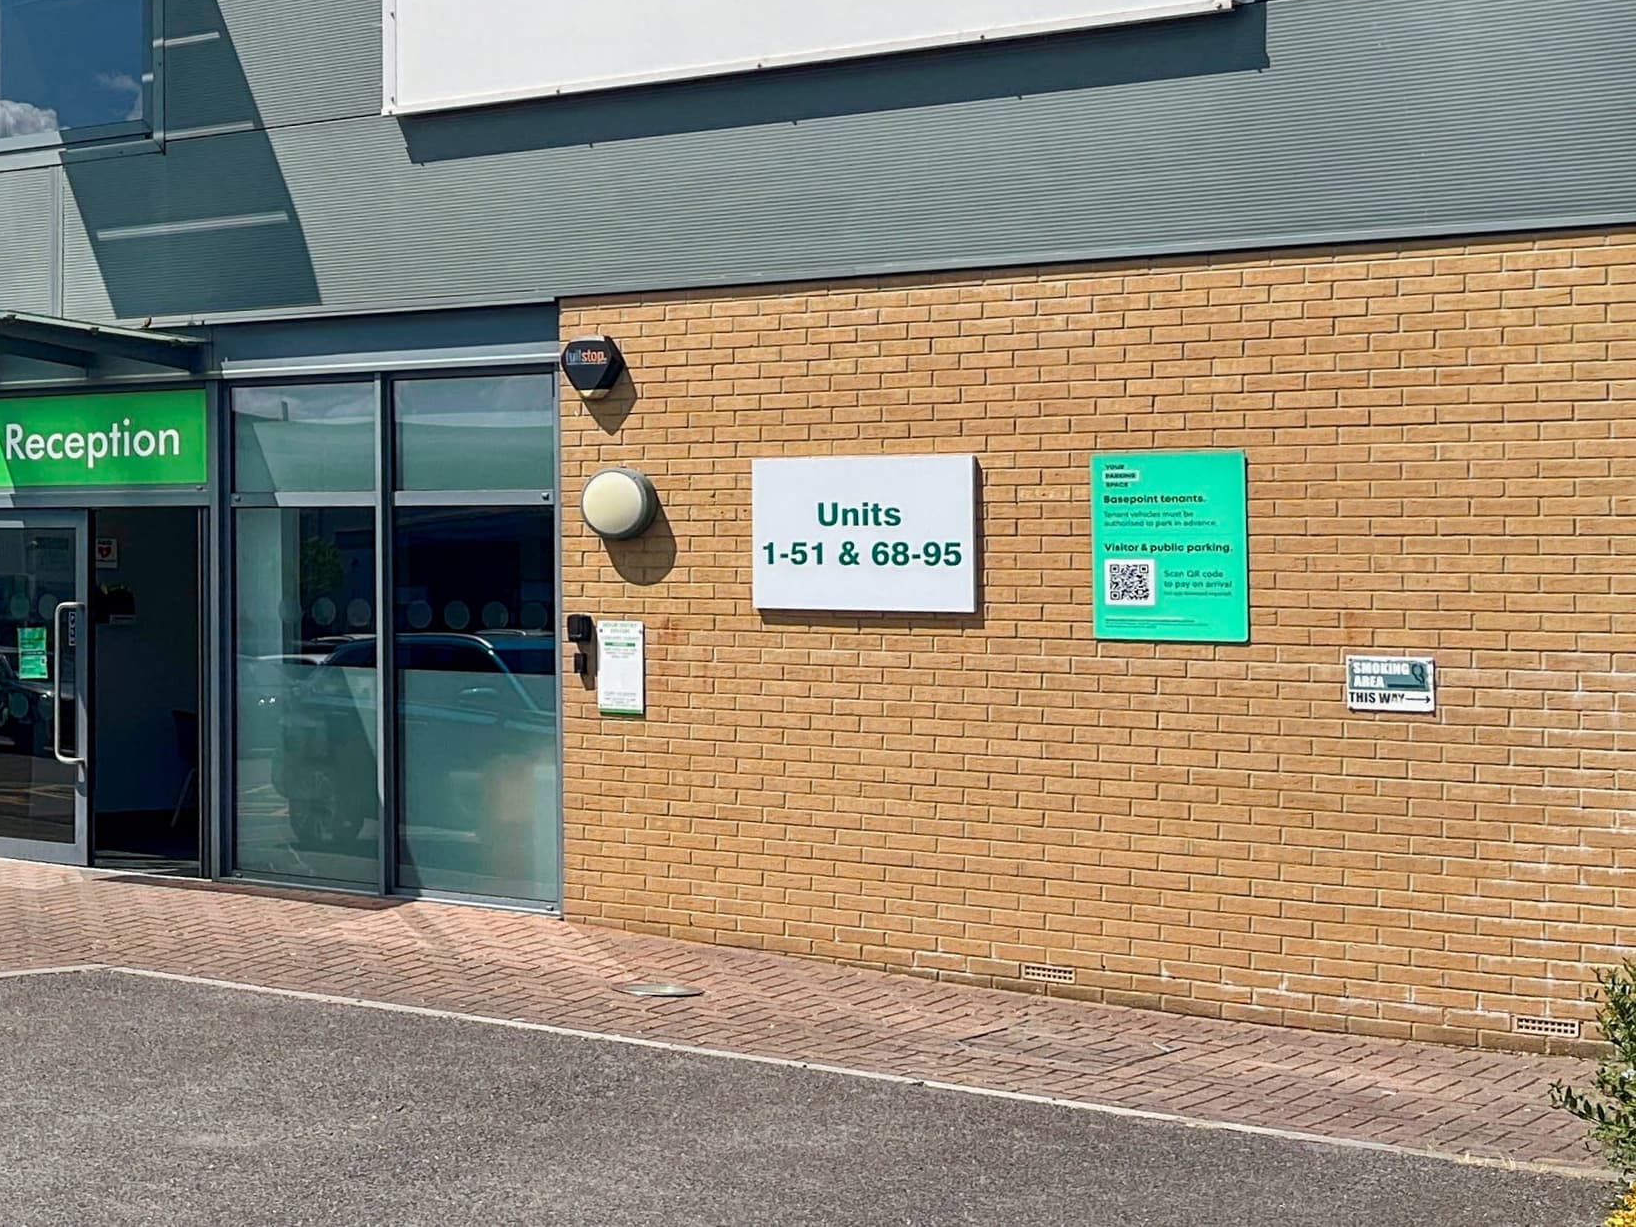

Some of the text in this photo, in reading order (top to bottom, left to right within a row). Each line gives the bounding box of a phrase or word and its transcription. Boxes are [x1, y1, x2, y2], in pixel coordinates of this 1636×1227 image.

[5, 418, 180, 469] Reception
[1103, 494, 1206, 505] Basepoint tenants.
[817, 502, 902, 527] Units
[762, 541, 963, 566] 1-51 & 68-95
[1104, 543, 1234, 554] Visitor & public parking.
[1163, 569, 1225, 579] Scan QR code
[1163, 580, 1174, 588] to
[1175, 581, 1191, 590] pay
[1205, 580, 1233, 588] arrival
[1353, 662, 1410, 675] SMOKING
[1353, 675, 1385, 688] AREA
[1349, 692, 1376, 703] THIS
